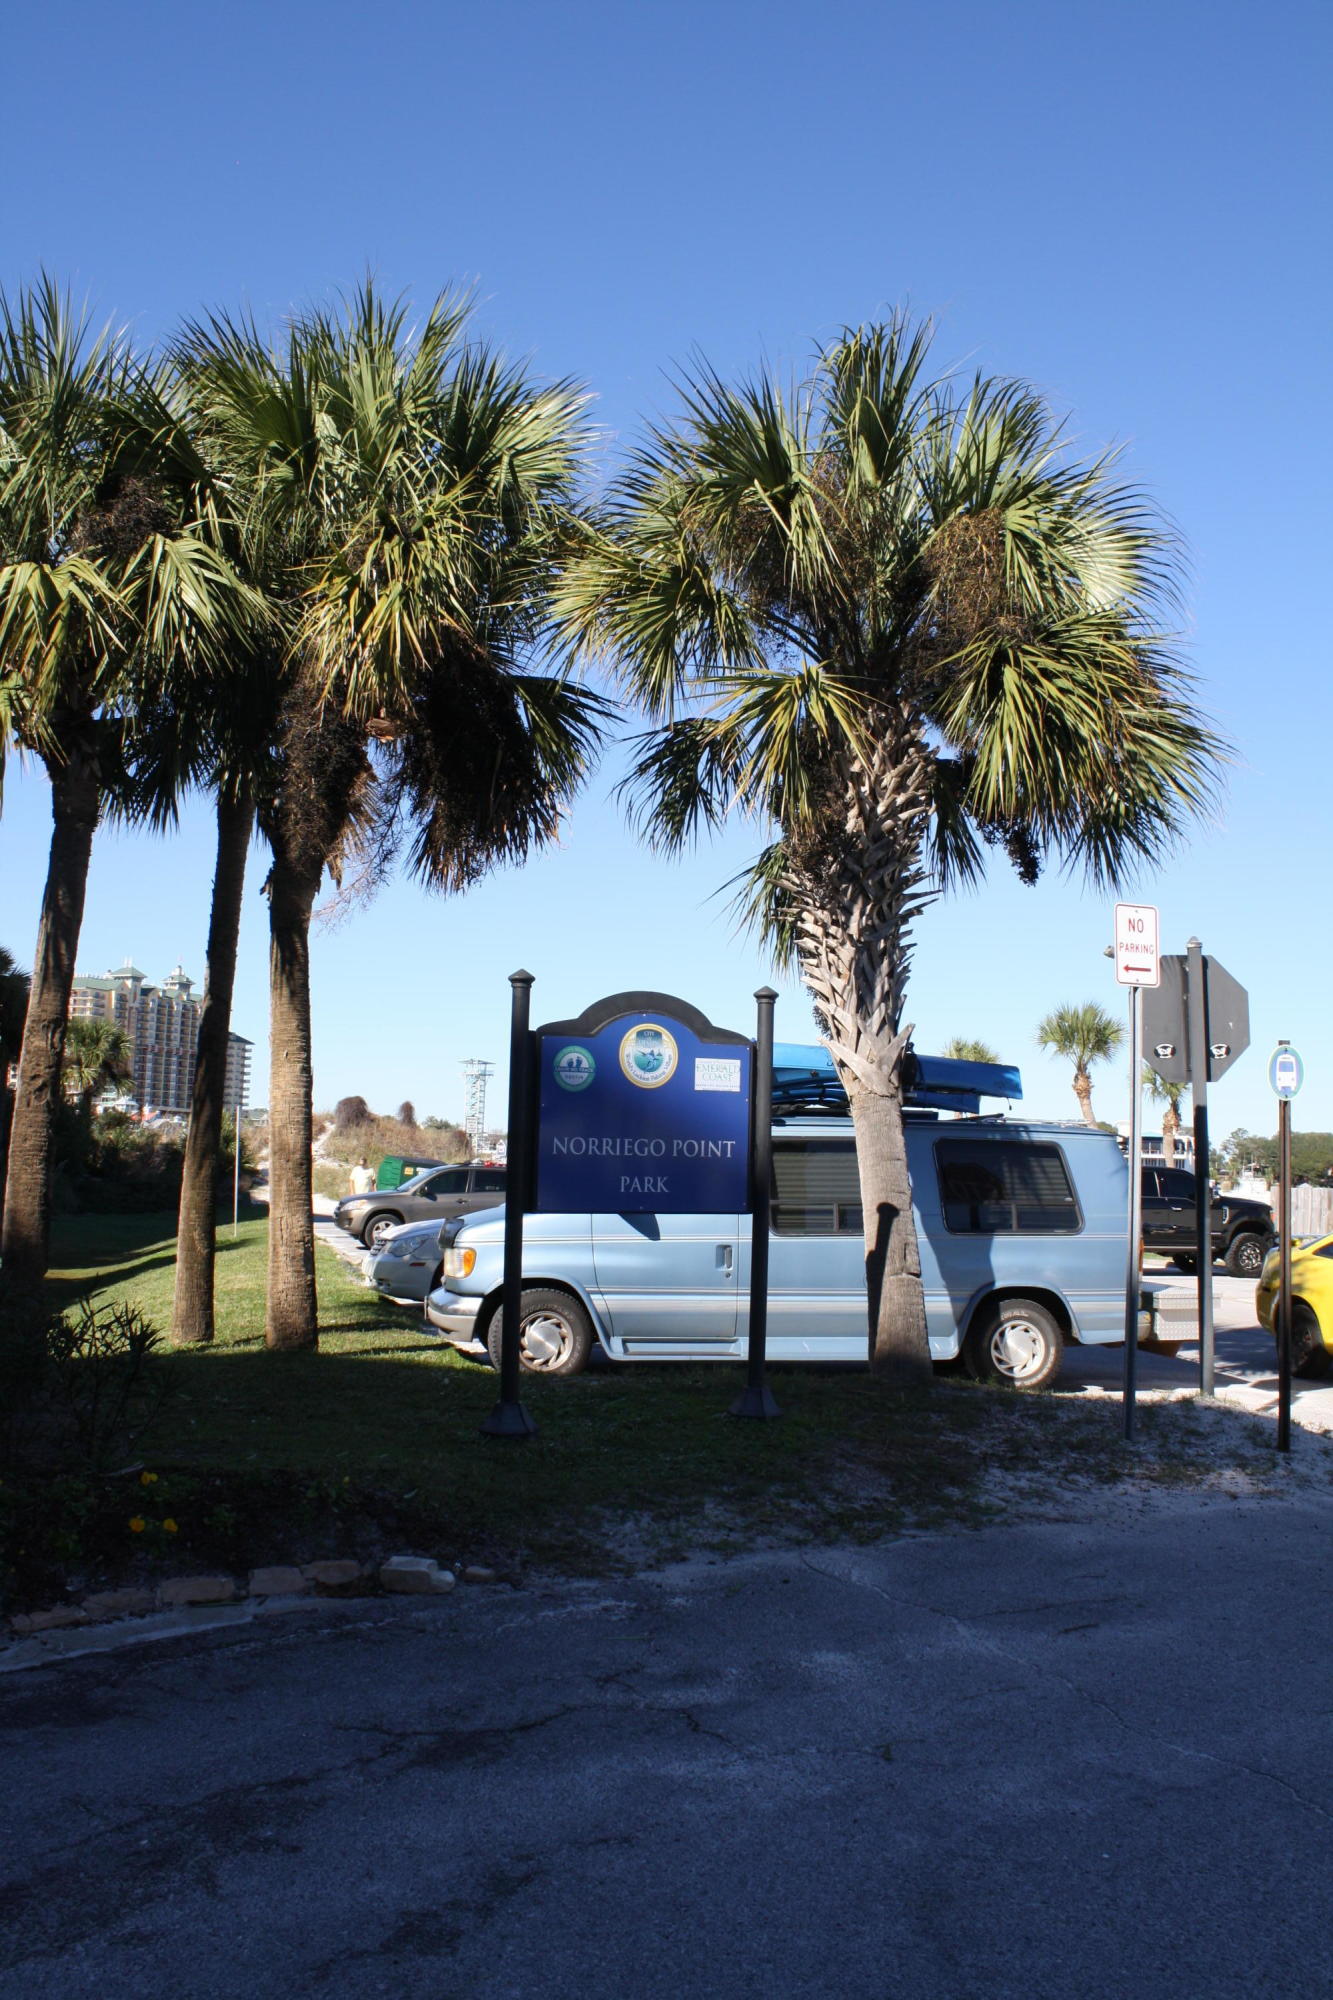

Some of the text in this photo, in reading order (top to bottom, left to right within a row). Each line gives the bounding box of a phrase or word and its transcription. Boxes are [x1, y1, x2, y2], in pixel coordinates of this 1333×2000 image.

[1128, 918, 1144, 933] NO
[1119, 942, 1154, 955] PARKING
[696, 1064, 740, 1075] EMERALD
[702, 1073, 733, 1082] COAST
[552, 1136, 735, 1158] NORRIEGO POINT
[619, 1175, 670, 1193] PARK
